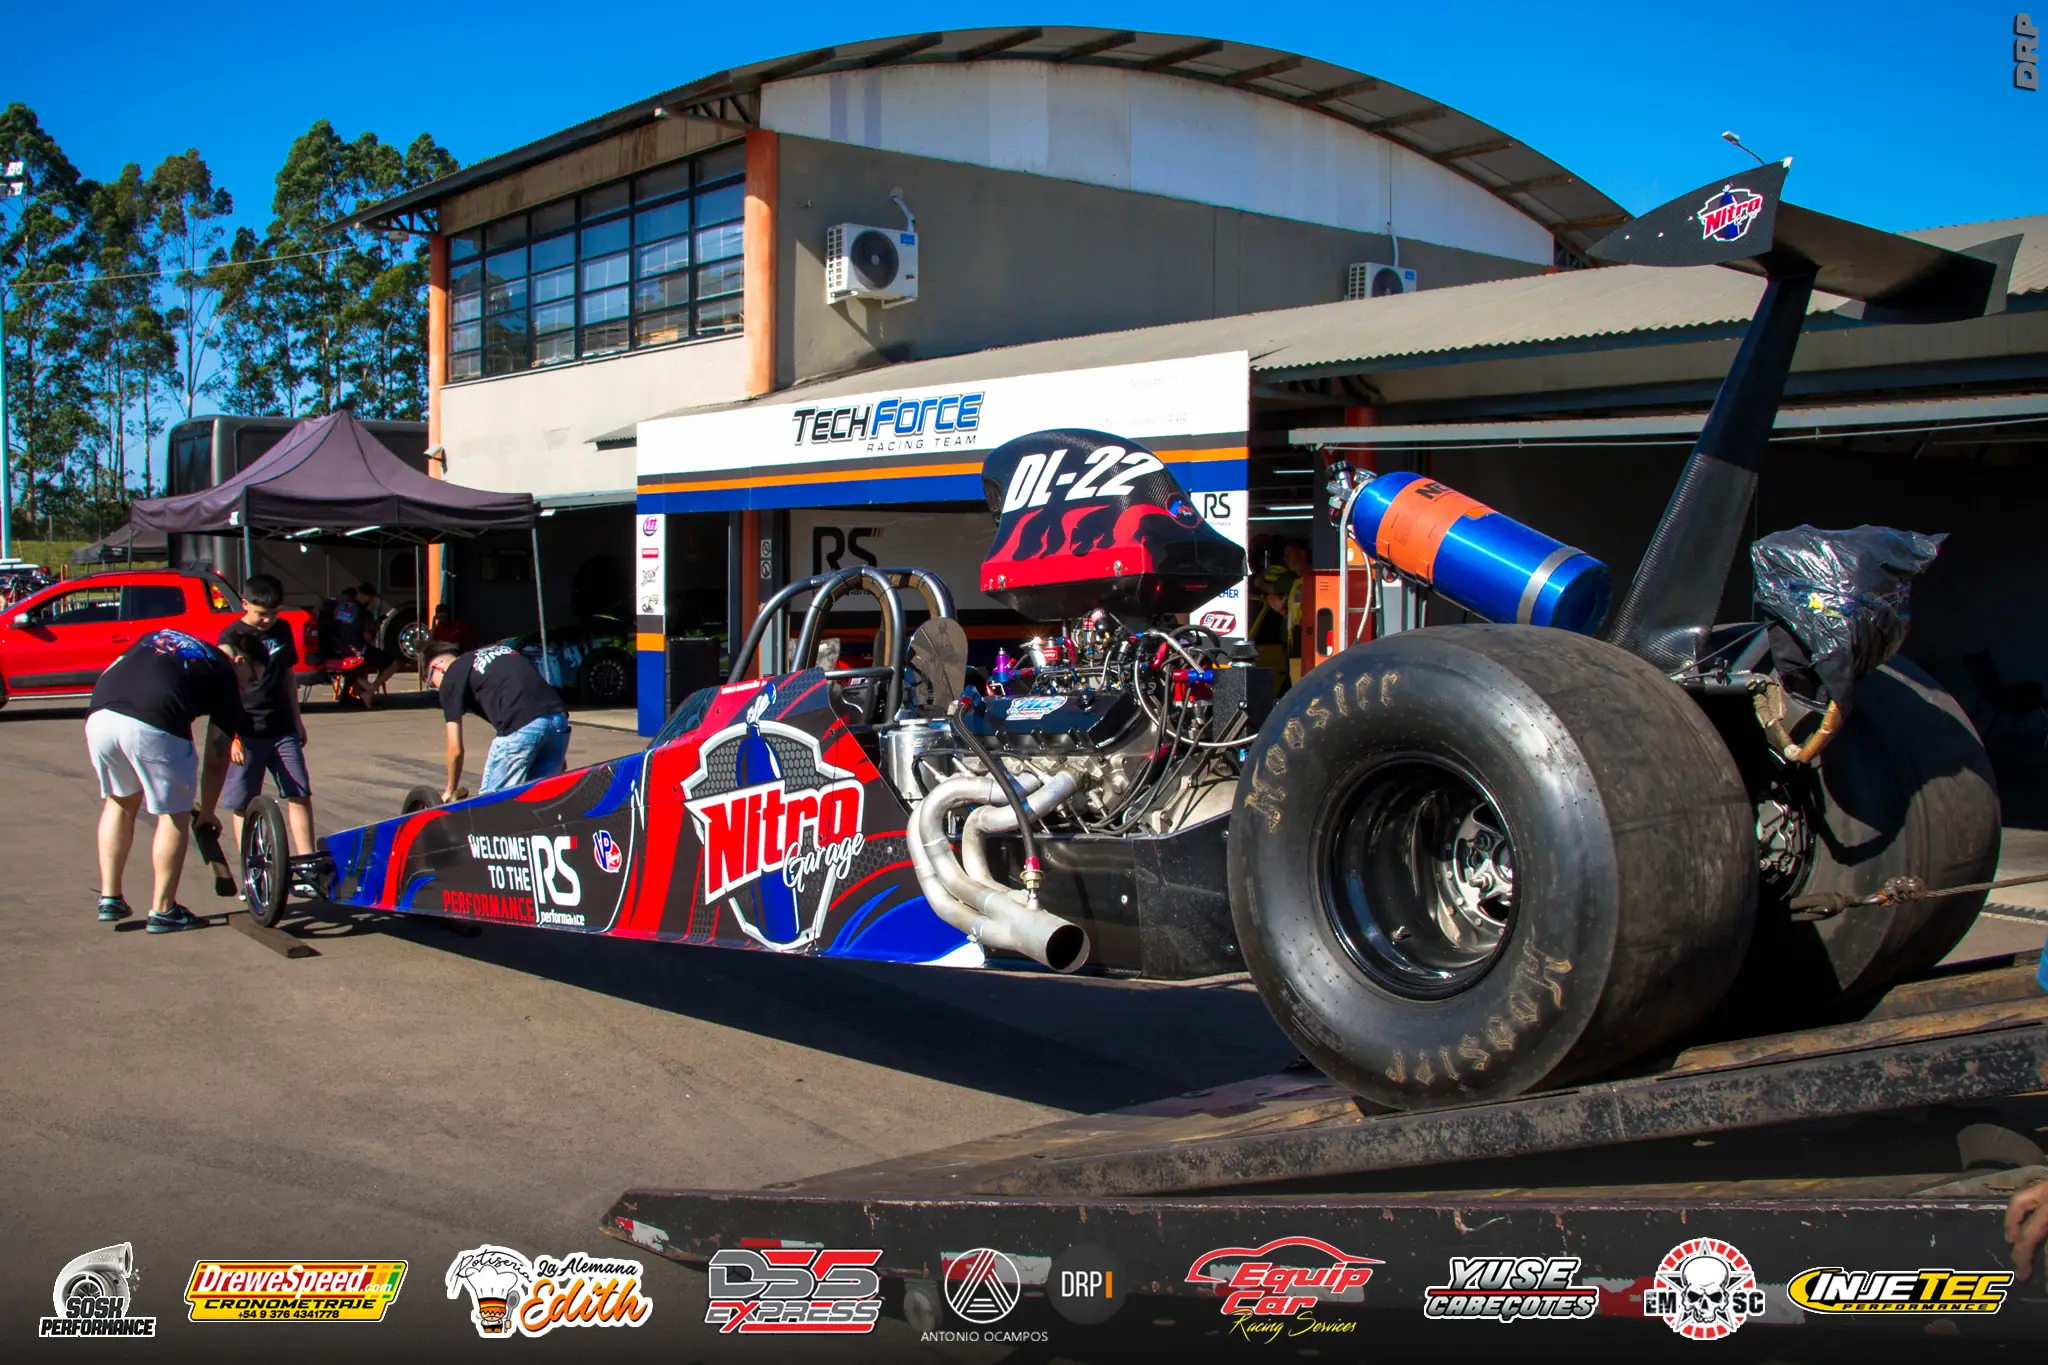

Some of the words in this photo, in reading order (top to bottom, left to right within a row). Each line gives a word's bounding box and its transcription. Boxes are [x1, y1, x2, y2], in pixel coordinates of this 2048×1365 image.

[866, 439, 924, 452] RACING
[935, 435, 977, 447] TEAM
[1204, 493, 1231, 518] RS
[813, 526, 884, 577] RS
[468, 834, 528, 861] WELCOME
[593, 829, 612, 870] VP
[783, 832, 865, 892] Garage
[487, 865, 506, 889] TO
[506, 866, 531, 892] THE
[531, 835, 581, 906] RS
[442, 890, 535, 922] PERFORMANCE
[540, 908, 586, 927] performance
